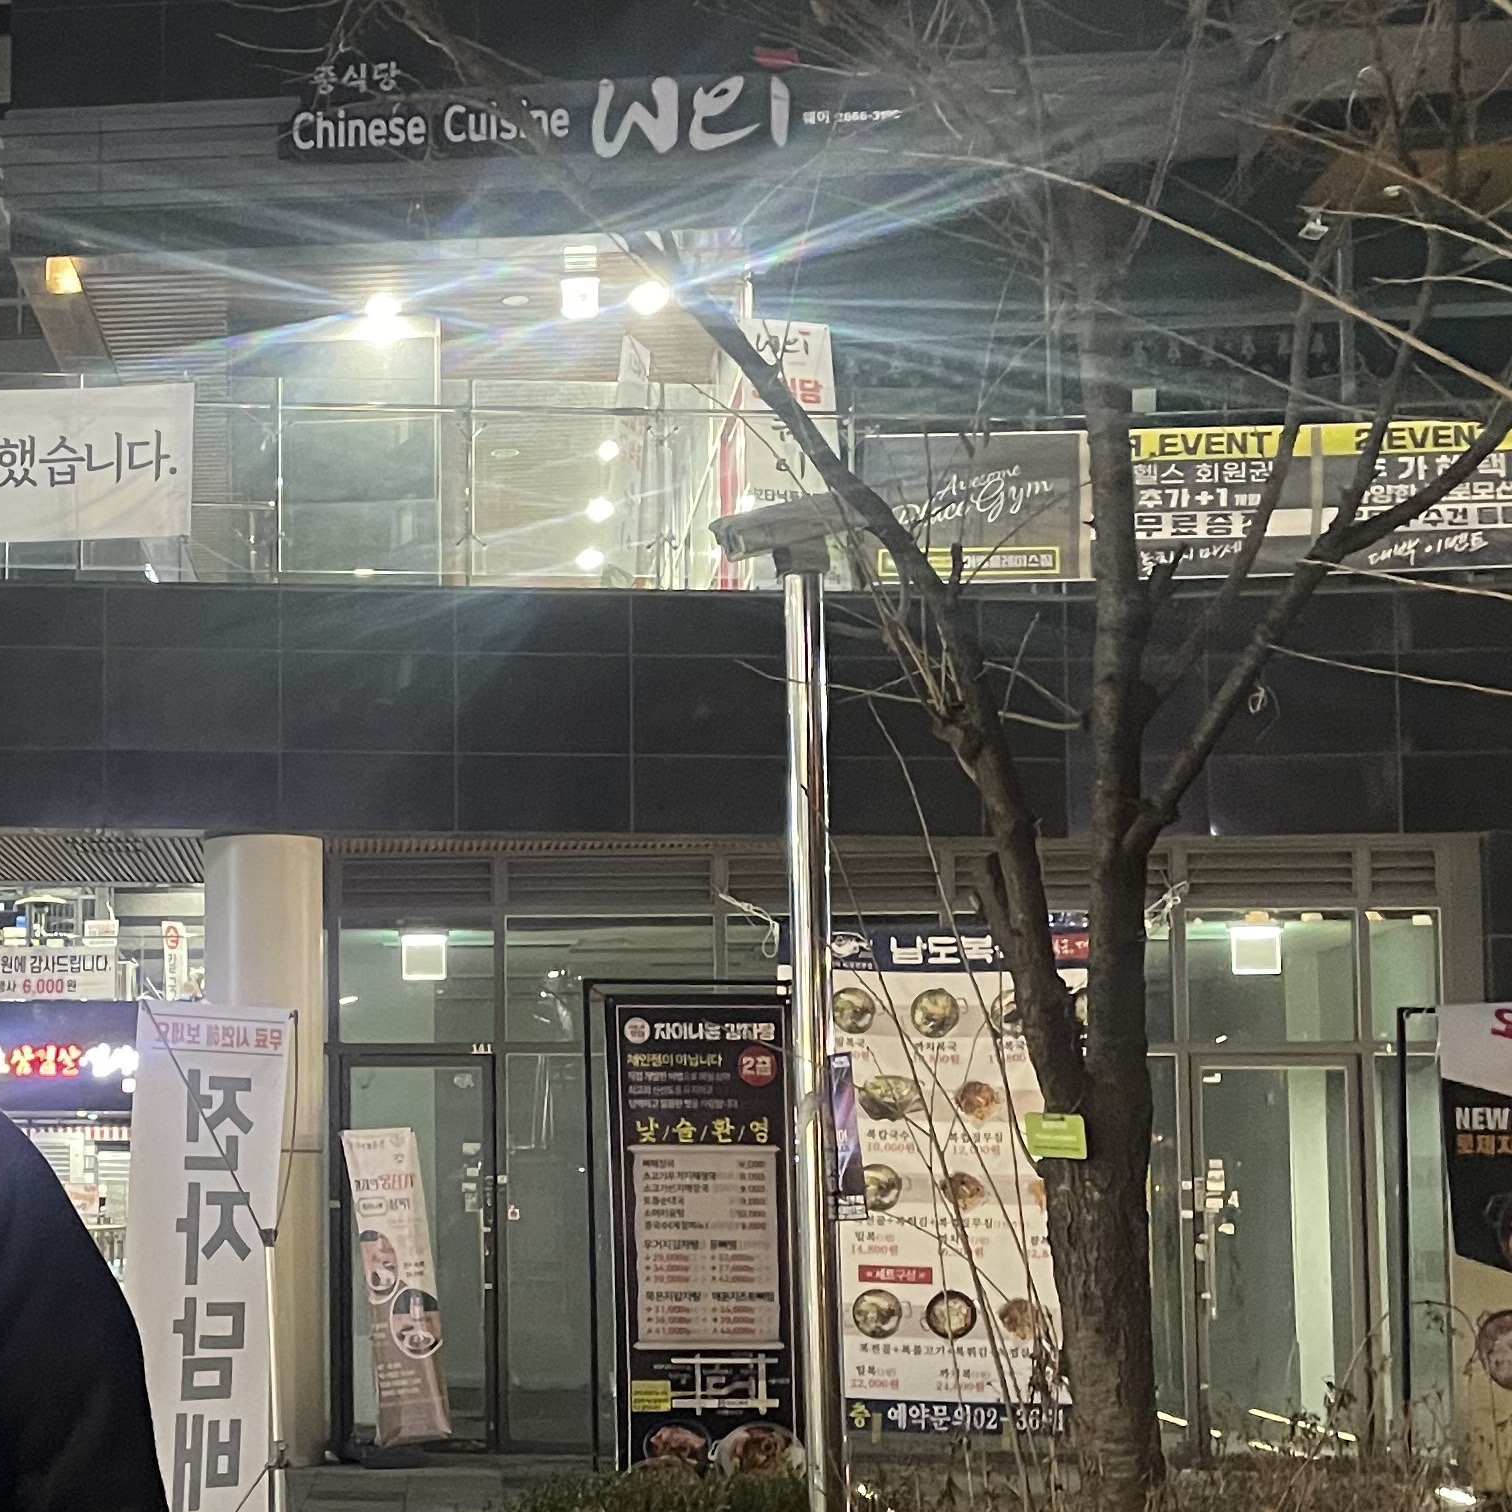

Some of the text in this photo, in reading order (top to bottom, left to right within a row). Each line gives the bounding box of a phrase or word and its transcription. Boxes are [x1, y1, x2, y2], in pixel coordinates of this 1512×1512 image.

[291, 102, 427, 150] Chinese
[1195, 461, 1274, 483] 회원권
[1138, 488, 1191, 508] 추가
[890, 934, 1005, 966] 남도복
[29, 953, 113, 975] 감사드립니다.
[1454, 1106, 1511, 1131] NEW
